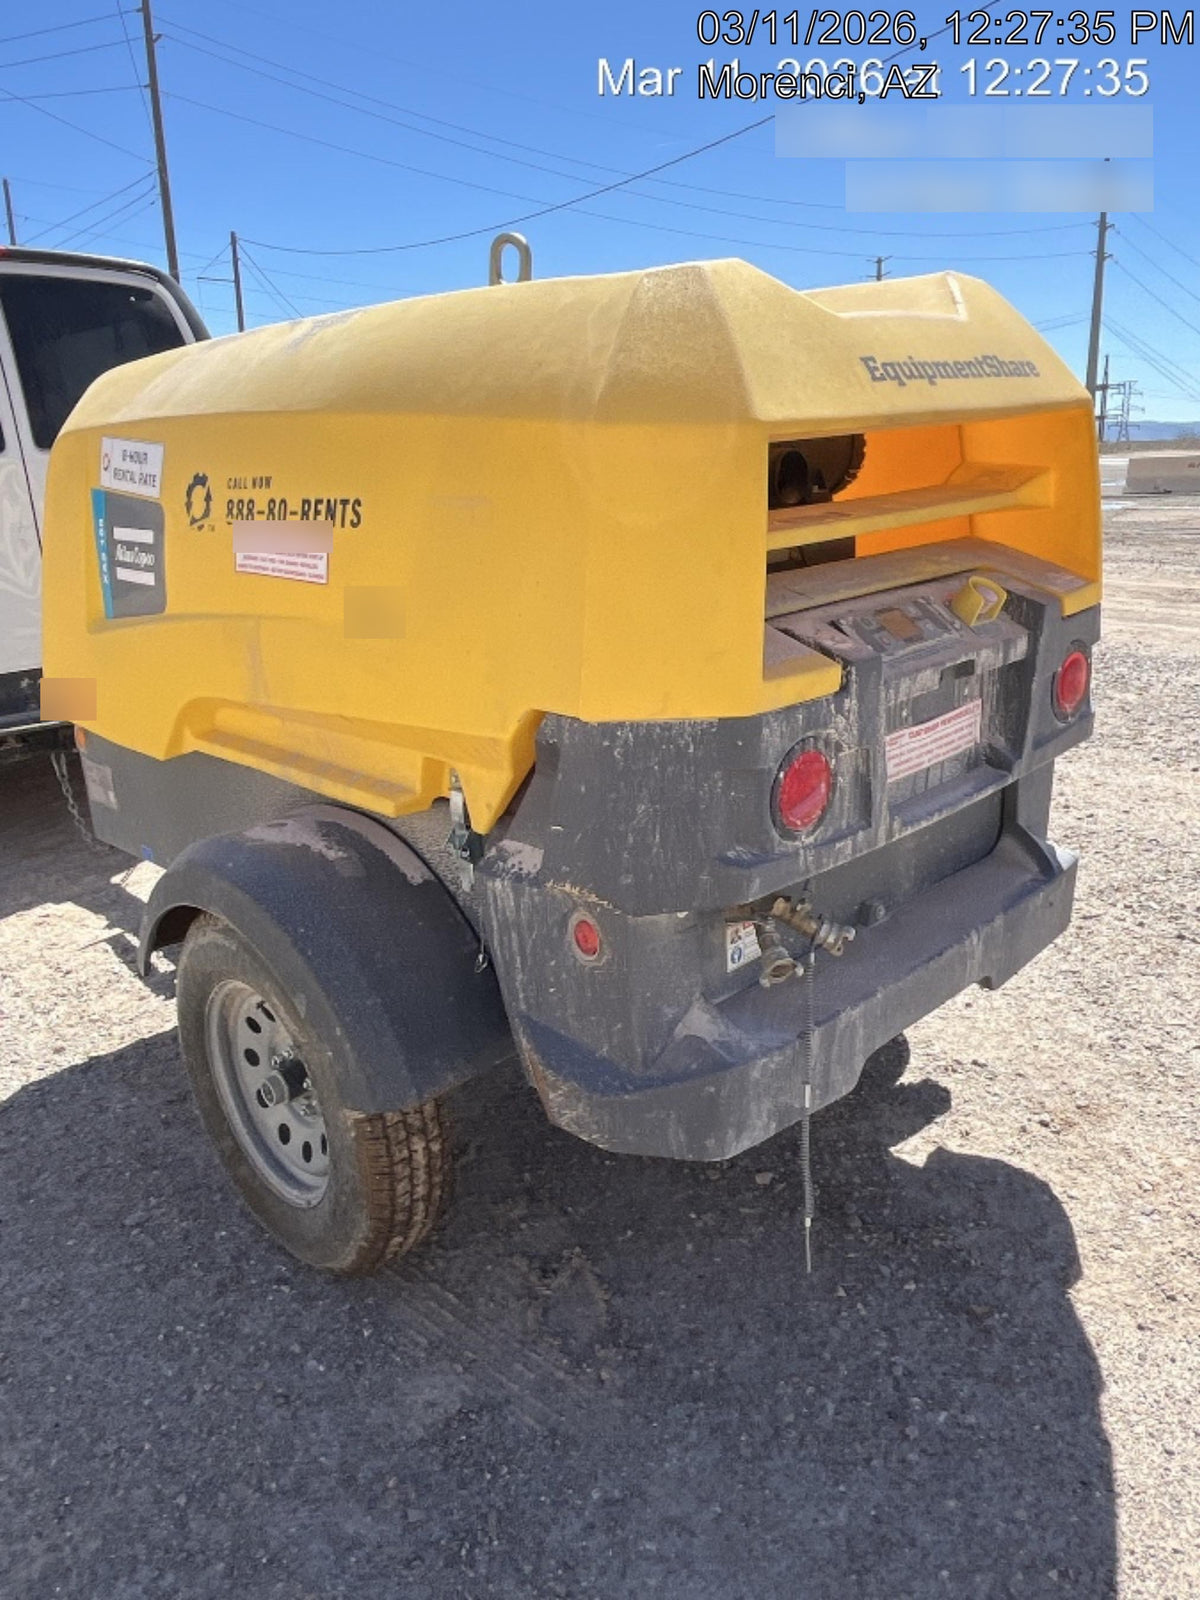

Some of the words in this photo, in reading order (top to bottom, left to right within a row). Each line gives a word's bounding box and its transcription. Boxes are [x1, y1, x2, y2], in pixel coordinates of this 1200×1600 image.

[859, 354, 1040, 387] EquipmentShare
[227, 476, 249, 490] CALL
[251, 475, 273, 490] NOW
